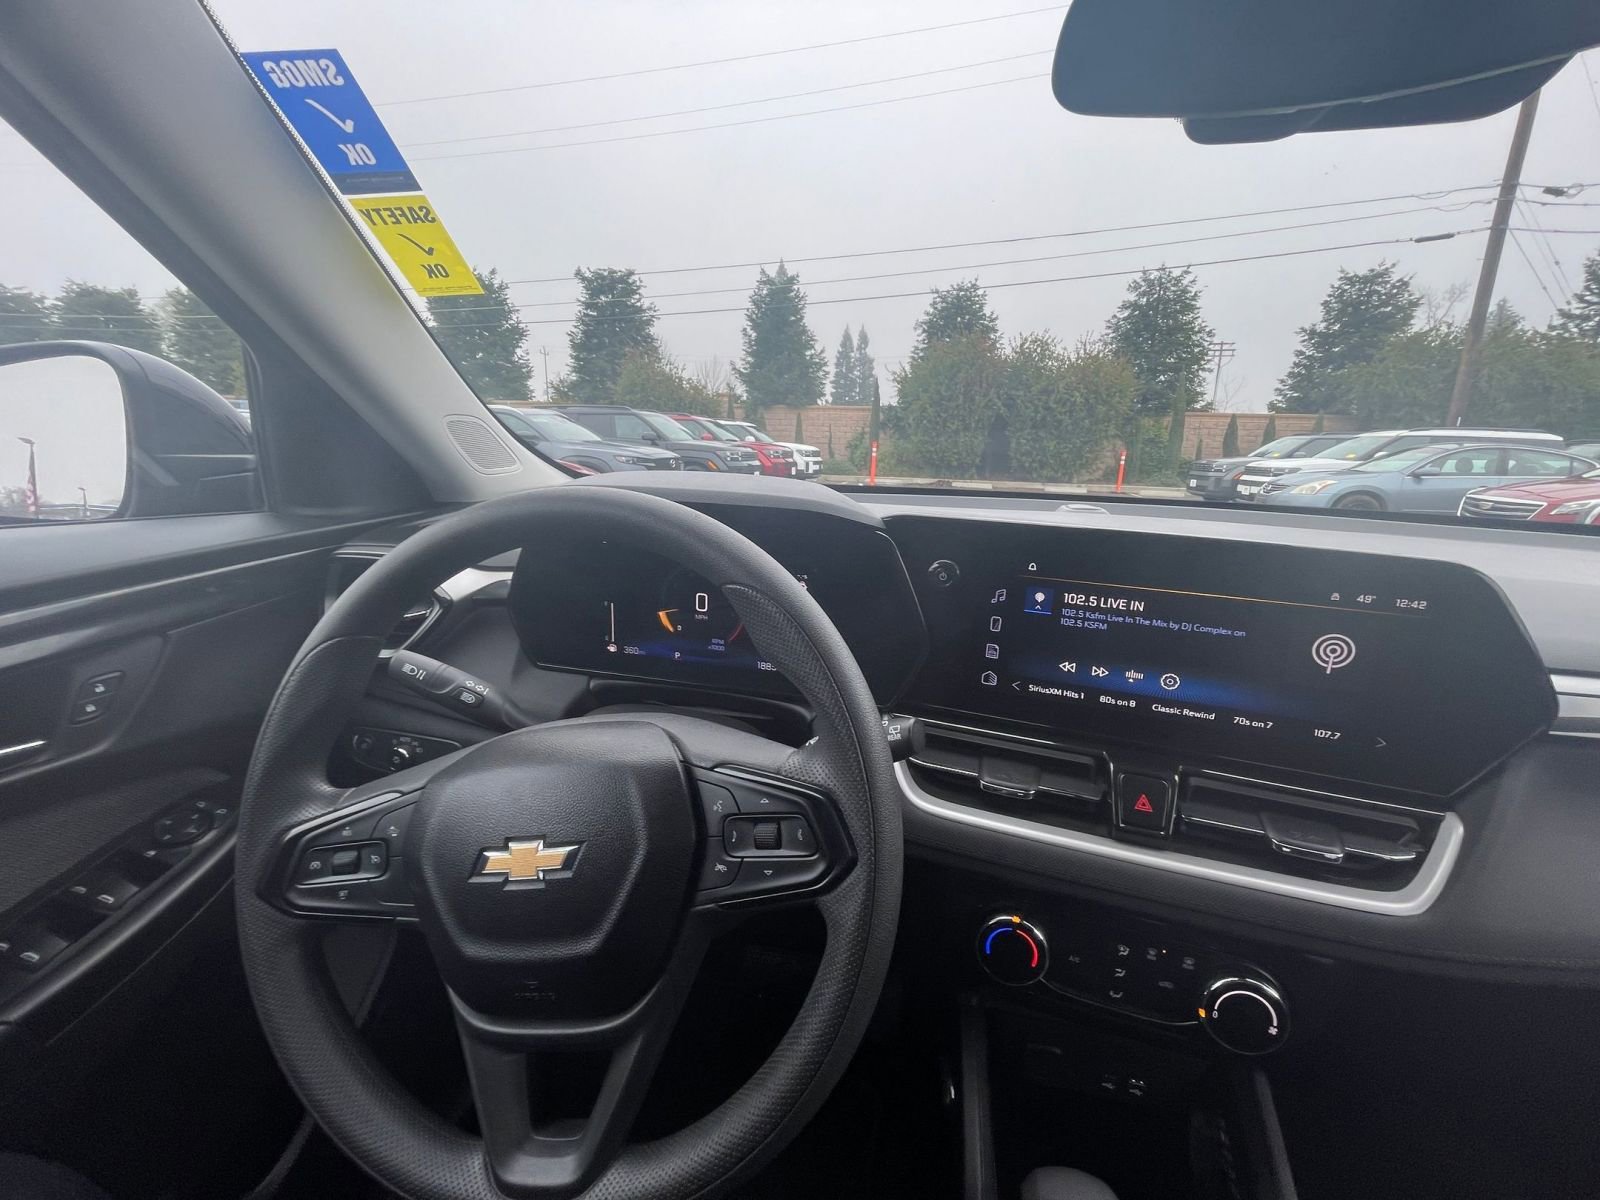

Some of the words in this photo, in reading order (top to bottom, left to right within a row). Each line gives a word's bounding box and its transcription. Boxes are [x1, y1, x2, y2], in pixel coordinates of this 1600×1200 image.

[695, 592, 709, 612] 0
[1063, 592, 1098, 607] 102.5
[1100, 597, 1127, 610] LIVE
[1129, 600, 1145, 612] IN
[1395, 598, 1427, 610] 12:42
[1060, 618, 1083, 627] 102.5
[1084, 621, 1108, 630] KSFM
[1061, 608, 1084, 618] 102.5
[1085, 611, 1106, 620] Ksfm
[1107, 613, 1124, 622] Live
[1125, 616, 1134, 624] In
[1135, 616, 1151, 626] The
[1151, 619, 1168, 628] Mix
[1169, 621, 1180, 631] by
[1181, 622, 1193, 632] DJ
[1193, 624, 1232, 635] Complex
[674, 651, 681, 659] P
[1028, 684, 1062, 696] SiriusXM
[1063, 690, 1079, 699] Hits
[1099, 695, 1116, 705] 80s
[1117, 699, 1128, 707] on
[1129, 700, 1137, 708] 8
[1151, 703, 1182, 715] Classic
[1182, 708, 1216, 720] Rewind
[1233, 716, 1251, 726] 70s
[1266, 721, 1274, 729] 7
[1313, 728, 1341, 740] 107.7
